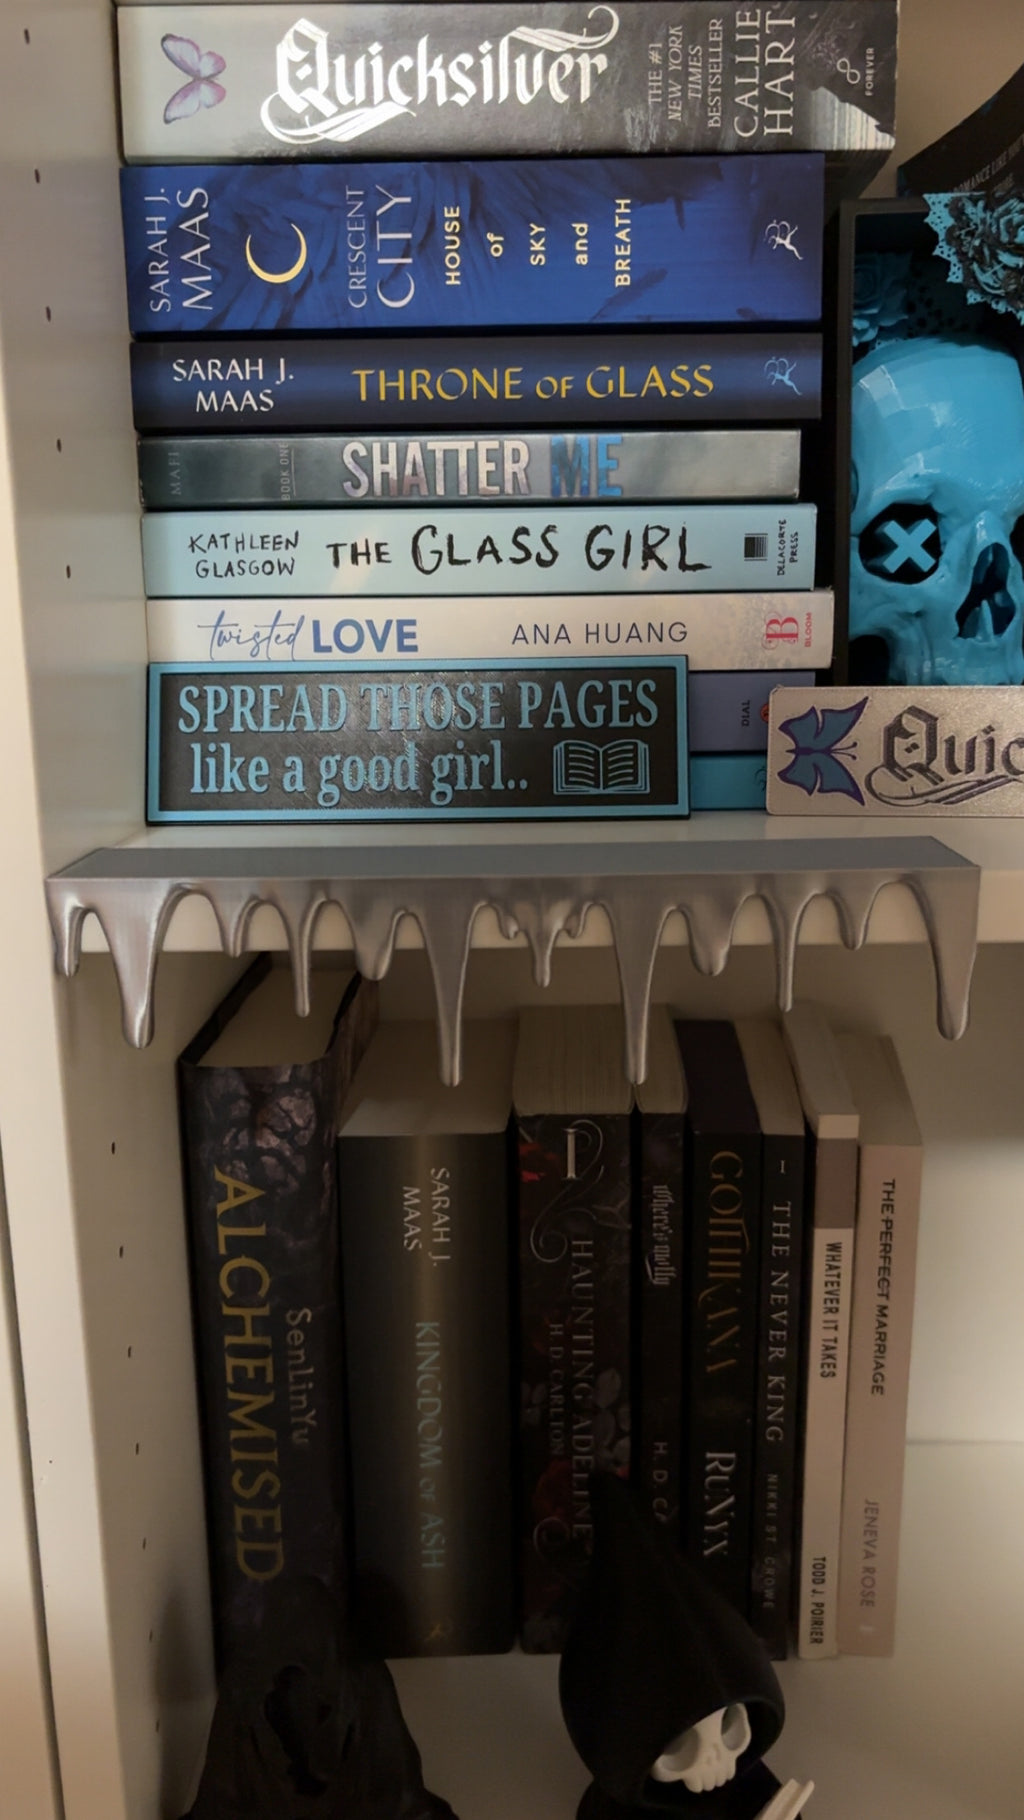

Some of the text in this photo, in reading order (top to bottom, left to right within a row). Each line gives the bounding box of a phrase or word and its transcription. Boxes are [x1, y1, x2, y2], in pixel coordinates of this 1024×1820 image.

[261, 5, 620, 144] Quicksilver
[648, 42, 663, 106] THE #1
[668, 25, 683, 121] NEW YORK
[688, 45, 703, 100] TIMES
[707, 19, 723, 128] BESTSELLER
[734, 9, 762, 138] CALLIE
[764, 11, 796, 137] HART
[865, 47, 875, 97] FOREVER
[144, 187, 171, 312] SARAH J.
[176, 188, 213, 310] MAAS
[346, 185, 368, 308] CRESCENT
[375, 184, 415, 308] CITY
[444, 206, 461, 285] HOUSE
[487, 232, 504, 257] of
[530, 223, 546, 266] SKY
[571, 223, 589, 265] and
[615, 199, 631, 287] BREATH
[172, 357, 295, 384] SARAH J.
[196, 389, 275, 412] MAAS
[351, 367, 523, 401] THRONE
[586, 365, 714, 398] GLASS
[168, 452, 181, 495] MAFI
[280, 442, 291, 500] BOOK ONE
[342, 435, 623, 497] SHATTER ME
[189, 531, 299, 554] KATHLEEN
[195, 557, 296, 579] GLASGOW
[326, 523, 712, 575] THE GLASS GIRL
[777, 519, 787, 576] DELLACORTE
[789, 531, 799, 563] PRESS
[197, 609, 419, 661] twisted LOVE
[512, 622, 688, 645] ANA HUANG
[804, 612, 813, 647] BLOOM
[178, 679, 658, 733] SPREAD THOSE PAGES
[742, 700, 750, 727] DIAL
[190, 740, 528, 807] like a good girl..
[401, 1185, 422, 1252] MAAS
[429, 1167, 452, 1267] SARAH J.
[698, 1150, 750, 1373] GOTHIKANA
[871, 1179, 896, 1395] THE PERFECT MARRIAGE
[765, 1201, 792, 1442] THE NEVER KING
[820, 1242, 842, 1379] WHATEVER IT TAKES
[213, 1166, 285, 1583] ALCHEMISED
[286, 1307, 316, 1446] SenLinYu
[415, 1322, 443, 1469] KINGDOM
[570, 1240, 595, 1540] HAUNTING ADELINE
[548, 1369, 565, 1455] CARLTON
[766, 1474, 779, 1516] NIKKI
[419, 1512, 446, 1570] ASH
[860, 1499, 879, 1608] JENEVA ROSE
[763, 1557, 776, 1609] CROWE
[810, 1556, 826, 1644] TODD J. POIRIER
